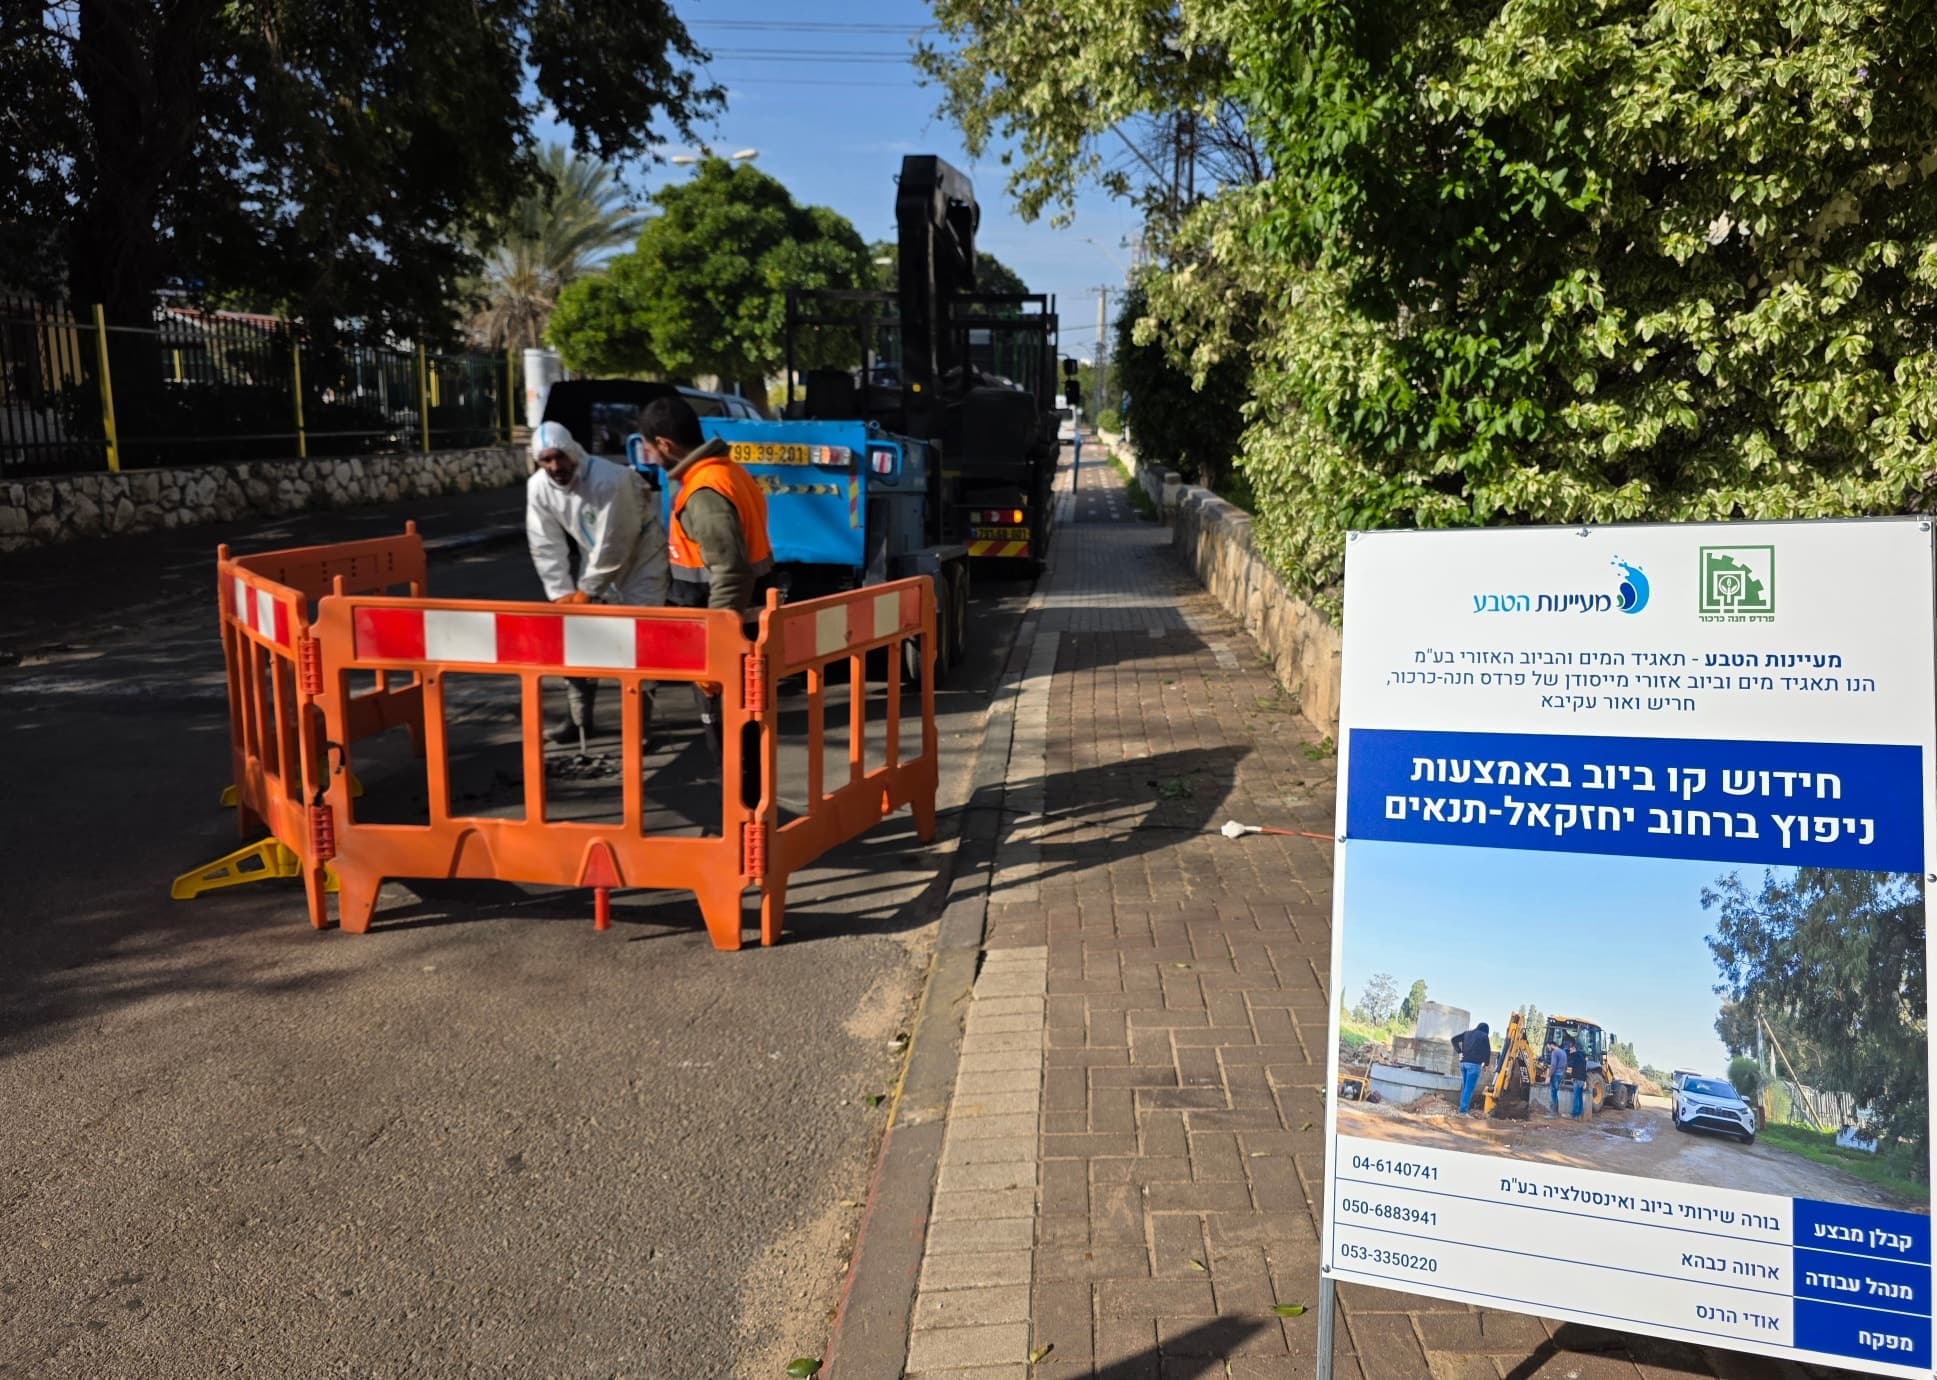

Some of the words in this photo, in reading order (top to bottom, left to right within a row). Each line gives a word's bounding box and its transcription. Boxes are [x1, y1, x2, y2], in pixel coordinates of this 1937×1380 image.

[1473, 594, 1530, 614] הטבע
[1535, 594, 1612, 614] מעיינות
[1698, 615, 1726, 623] כרכור
[1727, 615, 1747, 623] חנה
[1748, 615, 1775, 623] פרדס
[1415, 647, 1455, 664] בע"מ
[1459, 651, 1514, 665] האזורי
[1519, 651, 1573, 665] והביוב
[1579, 652, 1625, 666] המים
[1631, 652, 1686, 667] תאגיד
[1704, 653, 1759, 668] הטבע
[1764, 654, 1842, 669] מעיינות
[1386, 671, 1474, 687] חנה-כרכור,
[1480, 672, 1526, 686] פרדס
[1531, 670, 1559, 687] של
[1564, 673, 1629, 691] מייסודן
[1634, 674, 1681, 689] אזורי
[1687, 675, 1731, 690] וביוב
[1738, 676, 1774, 691] מים
[1779, 677, 1839, 692] תאגיד
[1845, 678, 1876, 693] הנו
[1541, 695, 1597, 713] עקיבא
[1603, 696, 1640, 710] ואור
[1647, 697, 1696, 712] חריש
[1410, 757, 1572, 788] באמצעות
[1582, 764, 1656, 791] ביוב
[1667, 767, 1706, 801] קו
[1722, 769, 1841, 799] חידוש
[1385, 795, 1635, 836] יחזקאל-תנאים
[1647, 808, 1759, 839] ברחוב
[1771, 814, 1874, 849] ניפוץ
[1352, 1155, 1438, 1181] 04-6140741
[1500, 1177, 1539, 1197] בע"מ
[1543, 1184, 1635, 1210] ואינסטלציה
[1342, 1198, 1437, 1226] 050-6883941
[1639, 1198, 1674, 1216] ביוב
[1677, 1203, 1735, 1224] שירותי
[1741, 1213, 1781, 1231] בורה
[1814, 1223, 1864, 1243] מבצע
[1869, 1228, 1912, 1252] קבלן
[1341, 1243, 1438, 1273] 053-3350220
[1681, 1252, 1727, 1272] כבהא
[1732, 1260, 1780, 1281] ארווה
[1806, 1271, 1860, 1292] עבודה
[1865, 1277, 1913, 1300] מנהל
[1695, 1305, 1738, 1324] הרנס
[1742, 1312, 1780, 1331] אודי
[1859, 1331, 1913, 1352] מפקח
